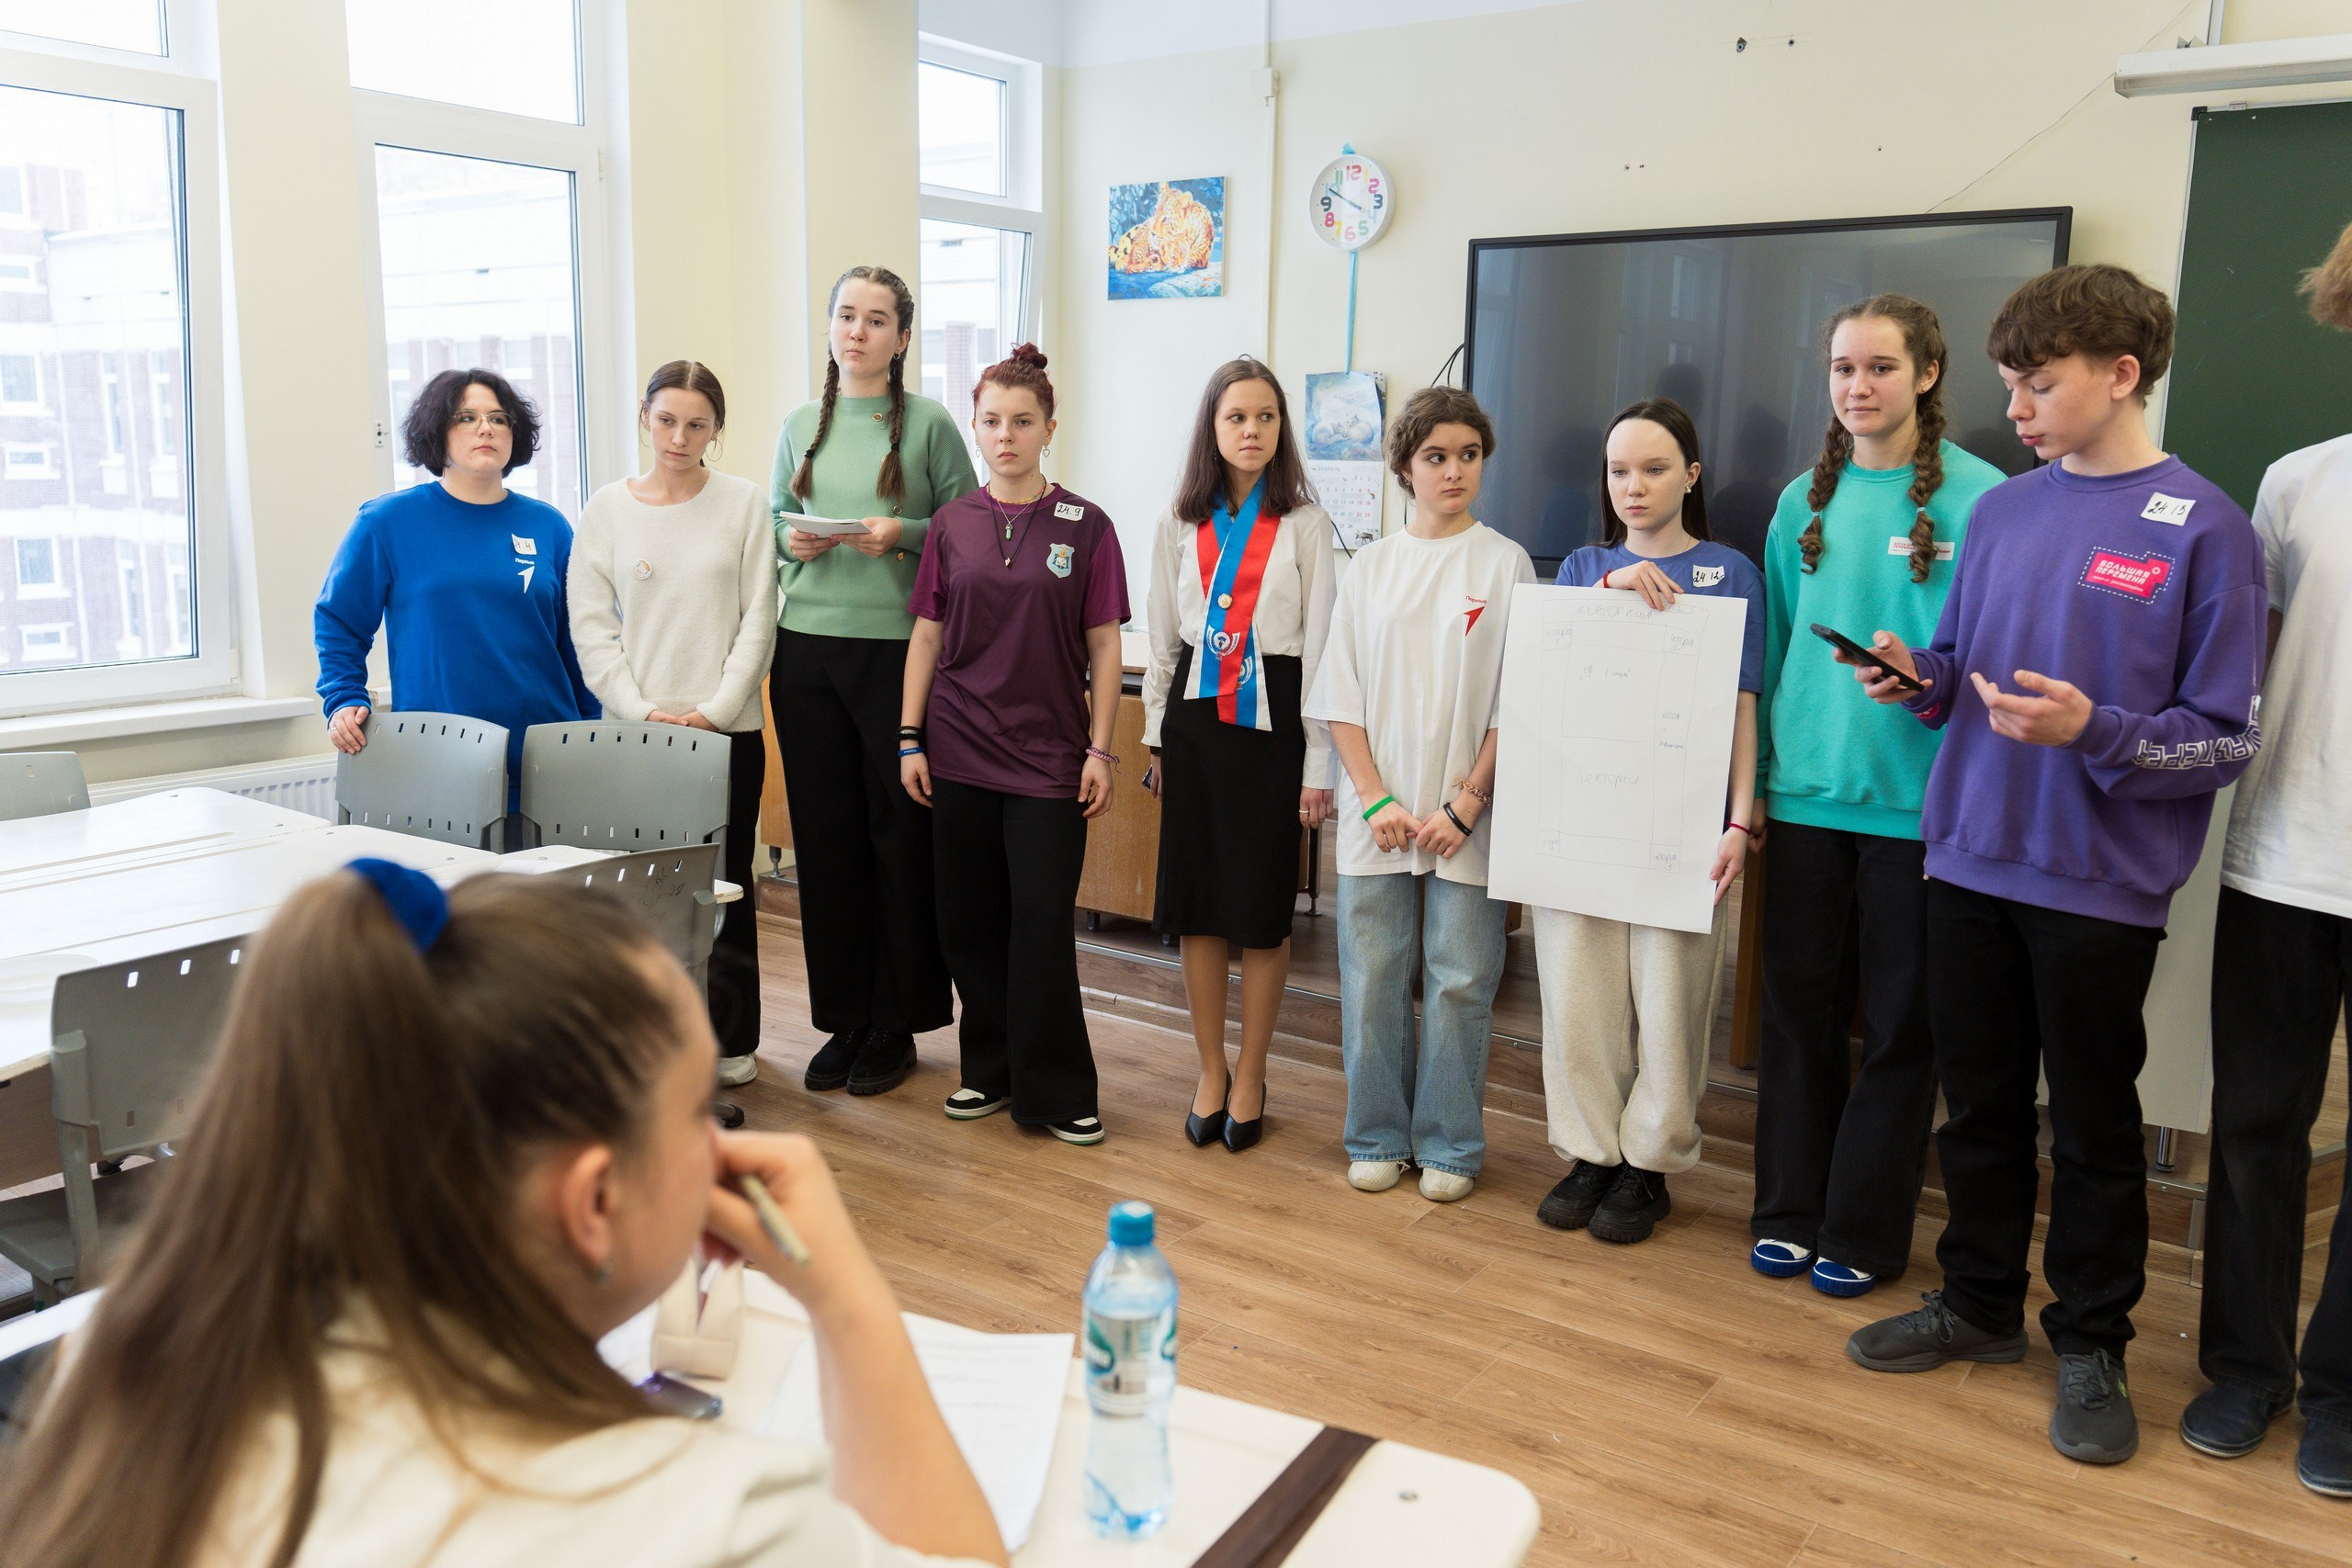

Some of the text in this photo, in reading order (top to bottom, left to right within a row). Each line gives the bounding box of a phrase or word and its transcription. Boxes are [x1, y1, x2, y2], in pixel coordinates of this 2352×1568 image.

[1336, 171, 1343, 186] 11
[1345, 164, 1362, 181] 12
[1325, 183, 1340, 197] 10
[1368, 177, 1379, 194] 2
[1320, 196, 1331, 212] 9
[1374, 194, 1383, 209] 3
[1325, 211, 1334, 227] 8
[1366, 209, 1377, 224] 4
[1334, 220, 1342, 237] 7
[1344, 225, 1356, 242] 6
[1358, 220, 1369, 236] 5
[2095, 566, 2147, 585] ПЕРЕМЕНА
[2098, 559, 2151, 579] БОЛЬШАЯ
[1465, 595, 1487, 604] Первые
